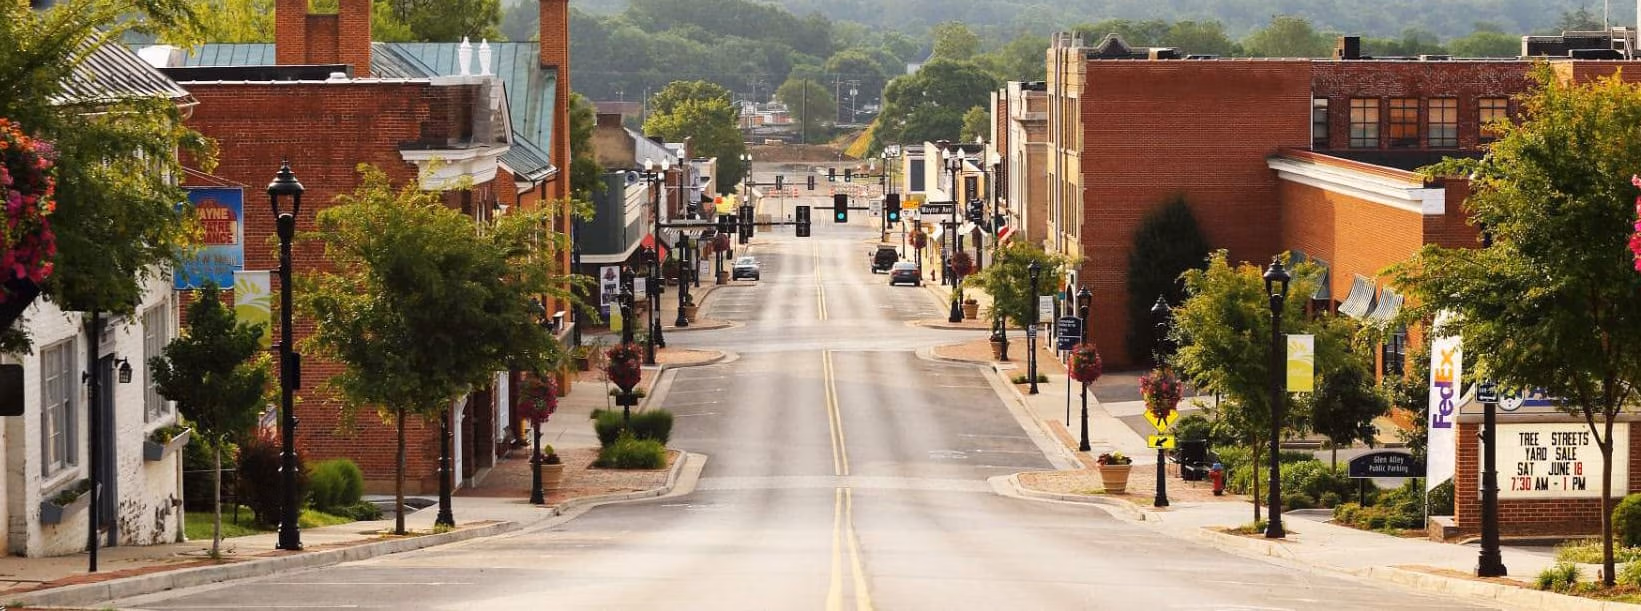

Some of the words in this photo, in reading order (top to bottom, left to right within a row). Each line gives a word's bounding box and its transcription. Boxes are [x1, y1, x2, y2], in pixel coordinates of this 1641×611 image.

[921, 206, 939, 214] Wayne
[1432, 349, 1455, 428] FedEx
[1519, 432, 1539, 446] TREE
[1551, 431, 1589, 446] STREETS
[1373, 455, 1388, 464] Glen
[1389, 455, 1404, 464] Alley
[1525, 447, 1547, 461] YARD
[1555, 447, 1577, 461] SALE
[1368, 464, 1386, 472] Public
[1387, 464, 1408, 473] Parking
[1517, 461, 1534, 476] SAT
[1548, 461, 1570, 476] JUNE
[1574, 461, 1582, 476] 18
[1511, 476, 1531, 491] 7:30
[1535, 476, 1548, 491] AM
[1563, 476, 1567, 491] 1
[1572, 476, 1586, 491] PM
